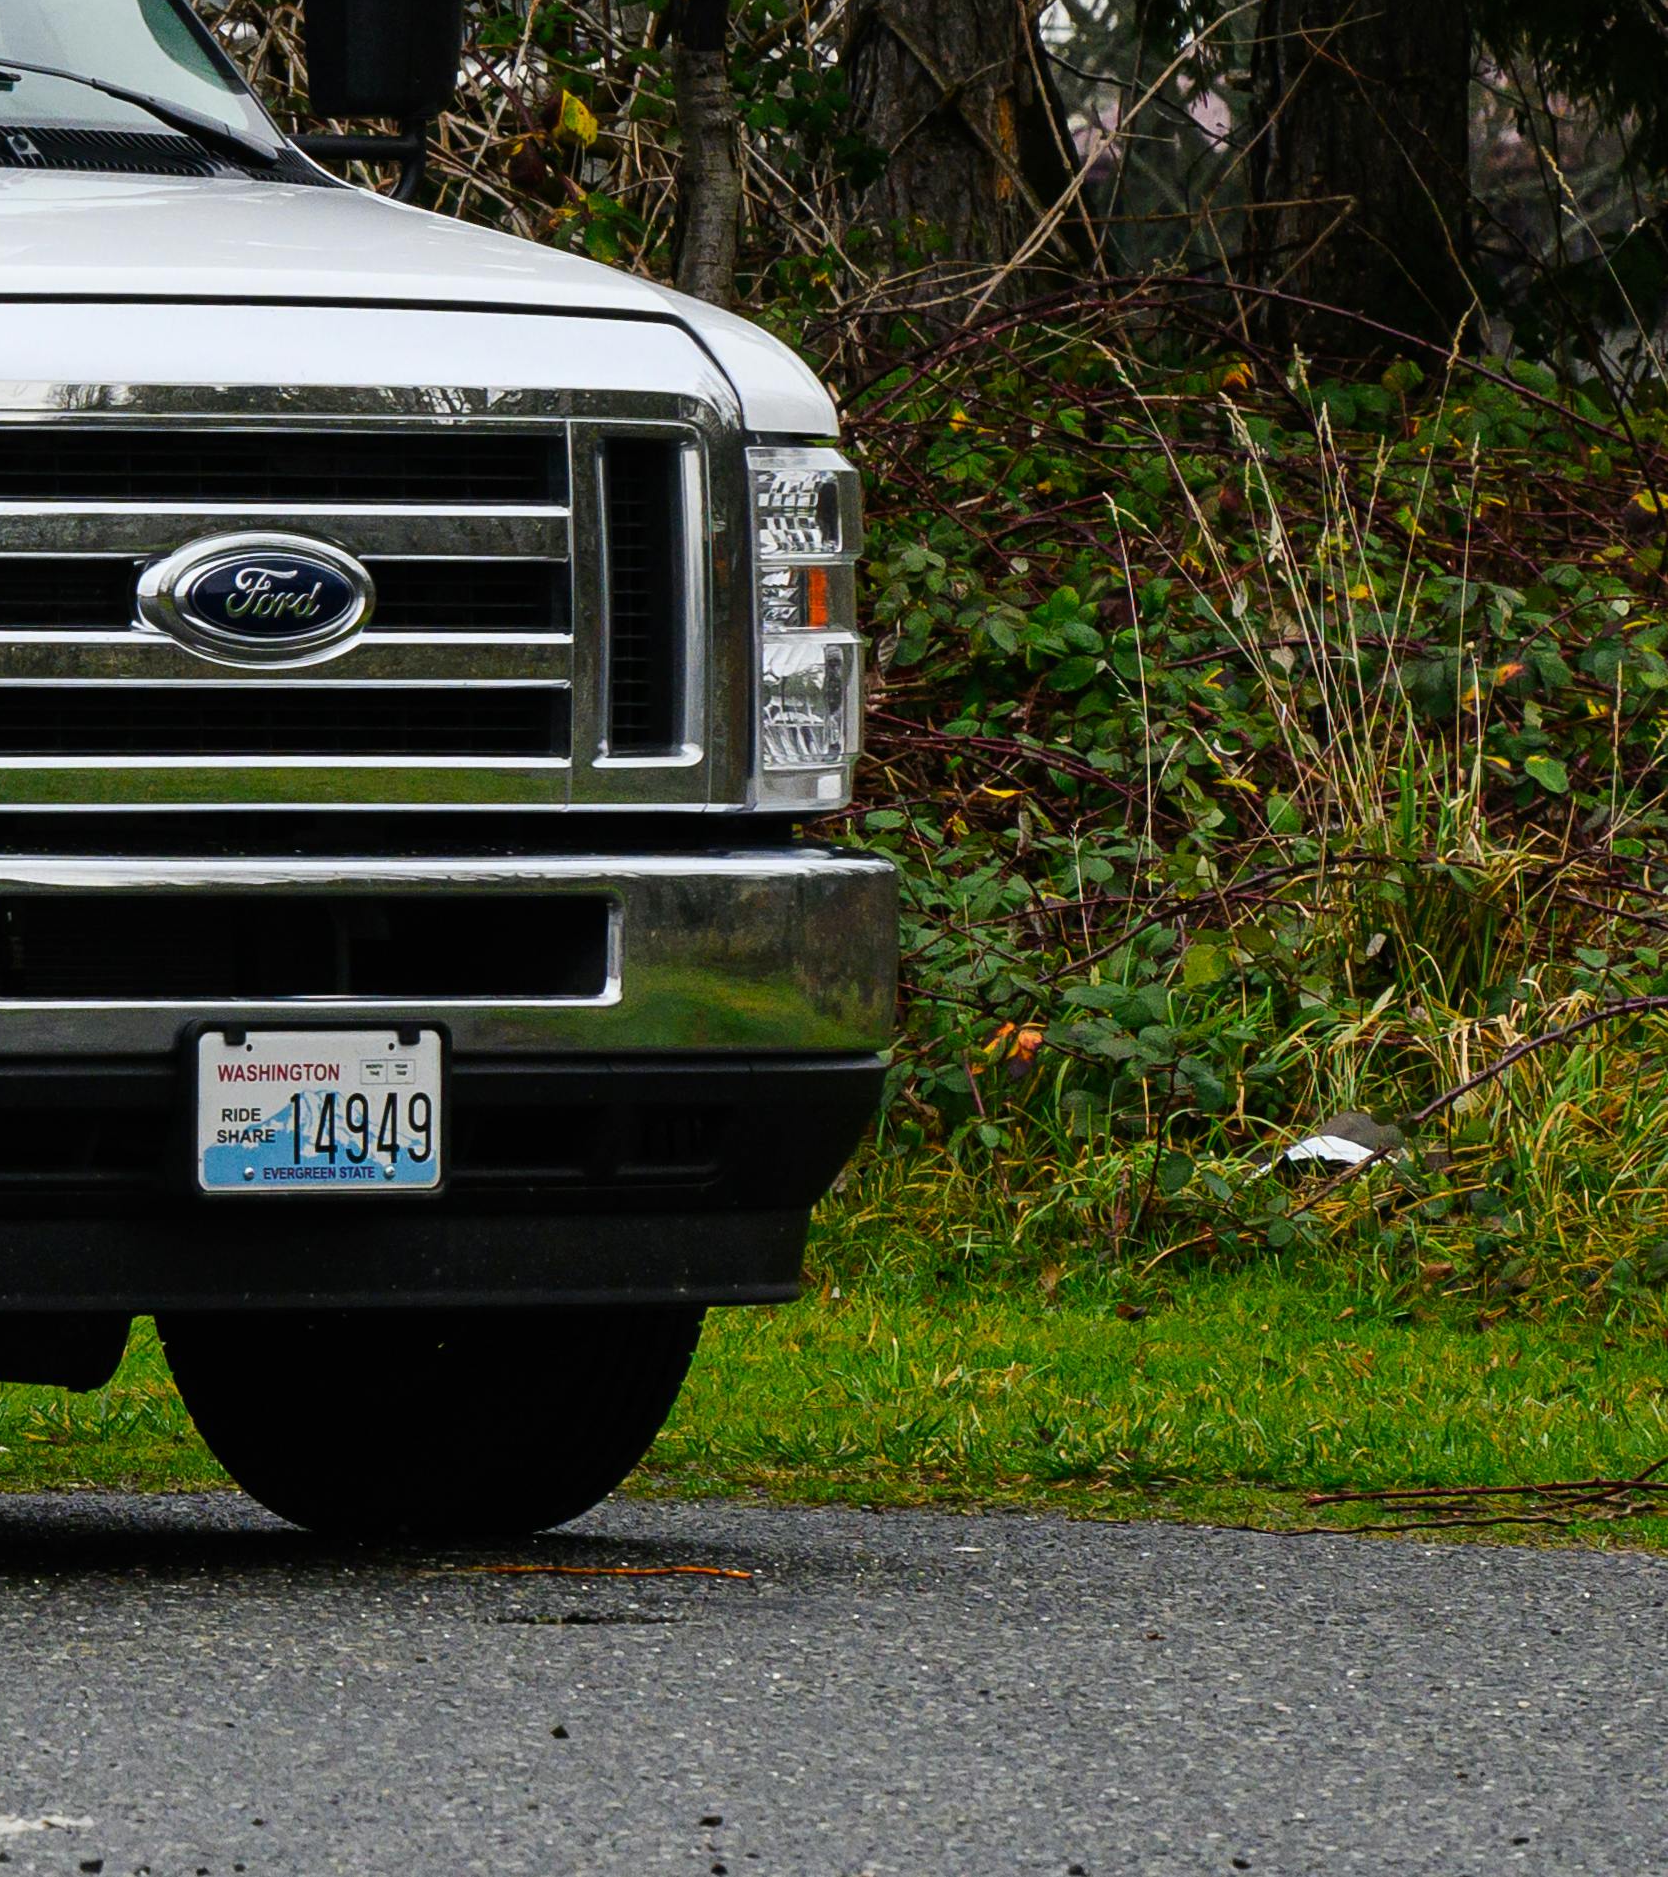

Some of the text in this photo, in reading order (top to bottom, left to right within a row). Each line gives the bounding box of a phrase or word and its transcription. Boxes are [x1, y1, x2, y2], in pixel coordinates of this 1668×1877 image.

[226, 567, 323, 619] Ford
[217, 1063, 340, 1082] WASHINGTON
[221, 1107, 262, 1123] RIDE
[216, 1128, 276, 1144] SHARE
[290, 1091, 432, 1165] 14949
[263, 1165, 375, 1180] EVERGREEN STATE
